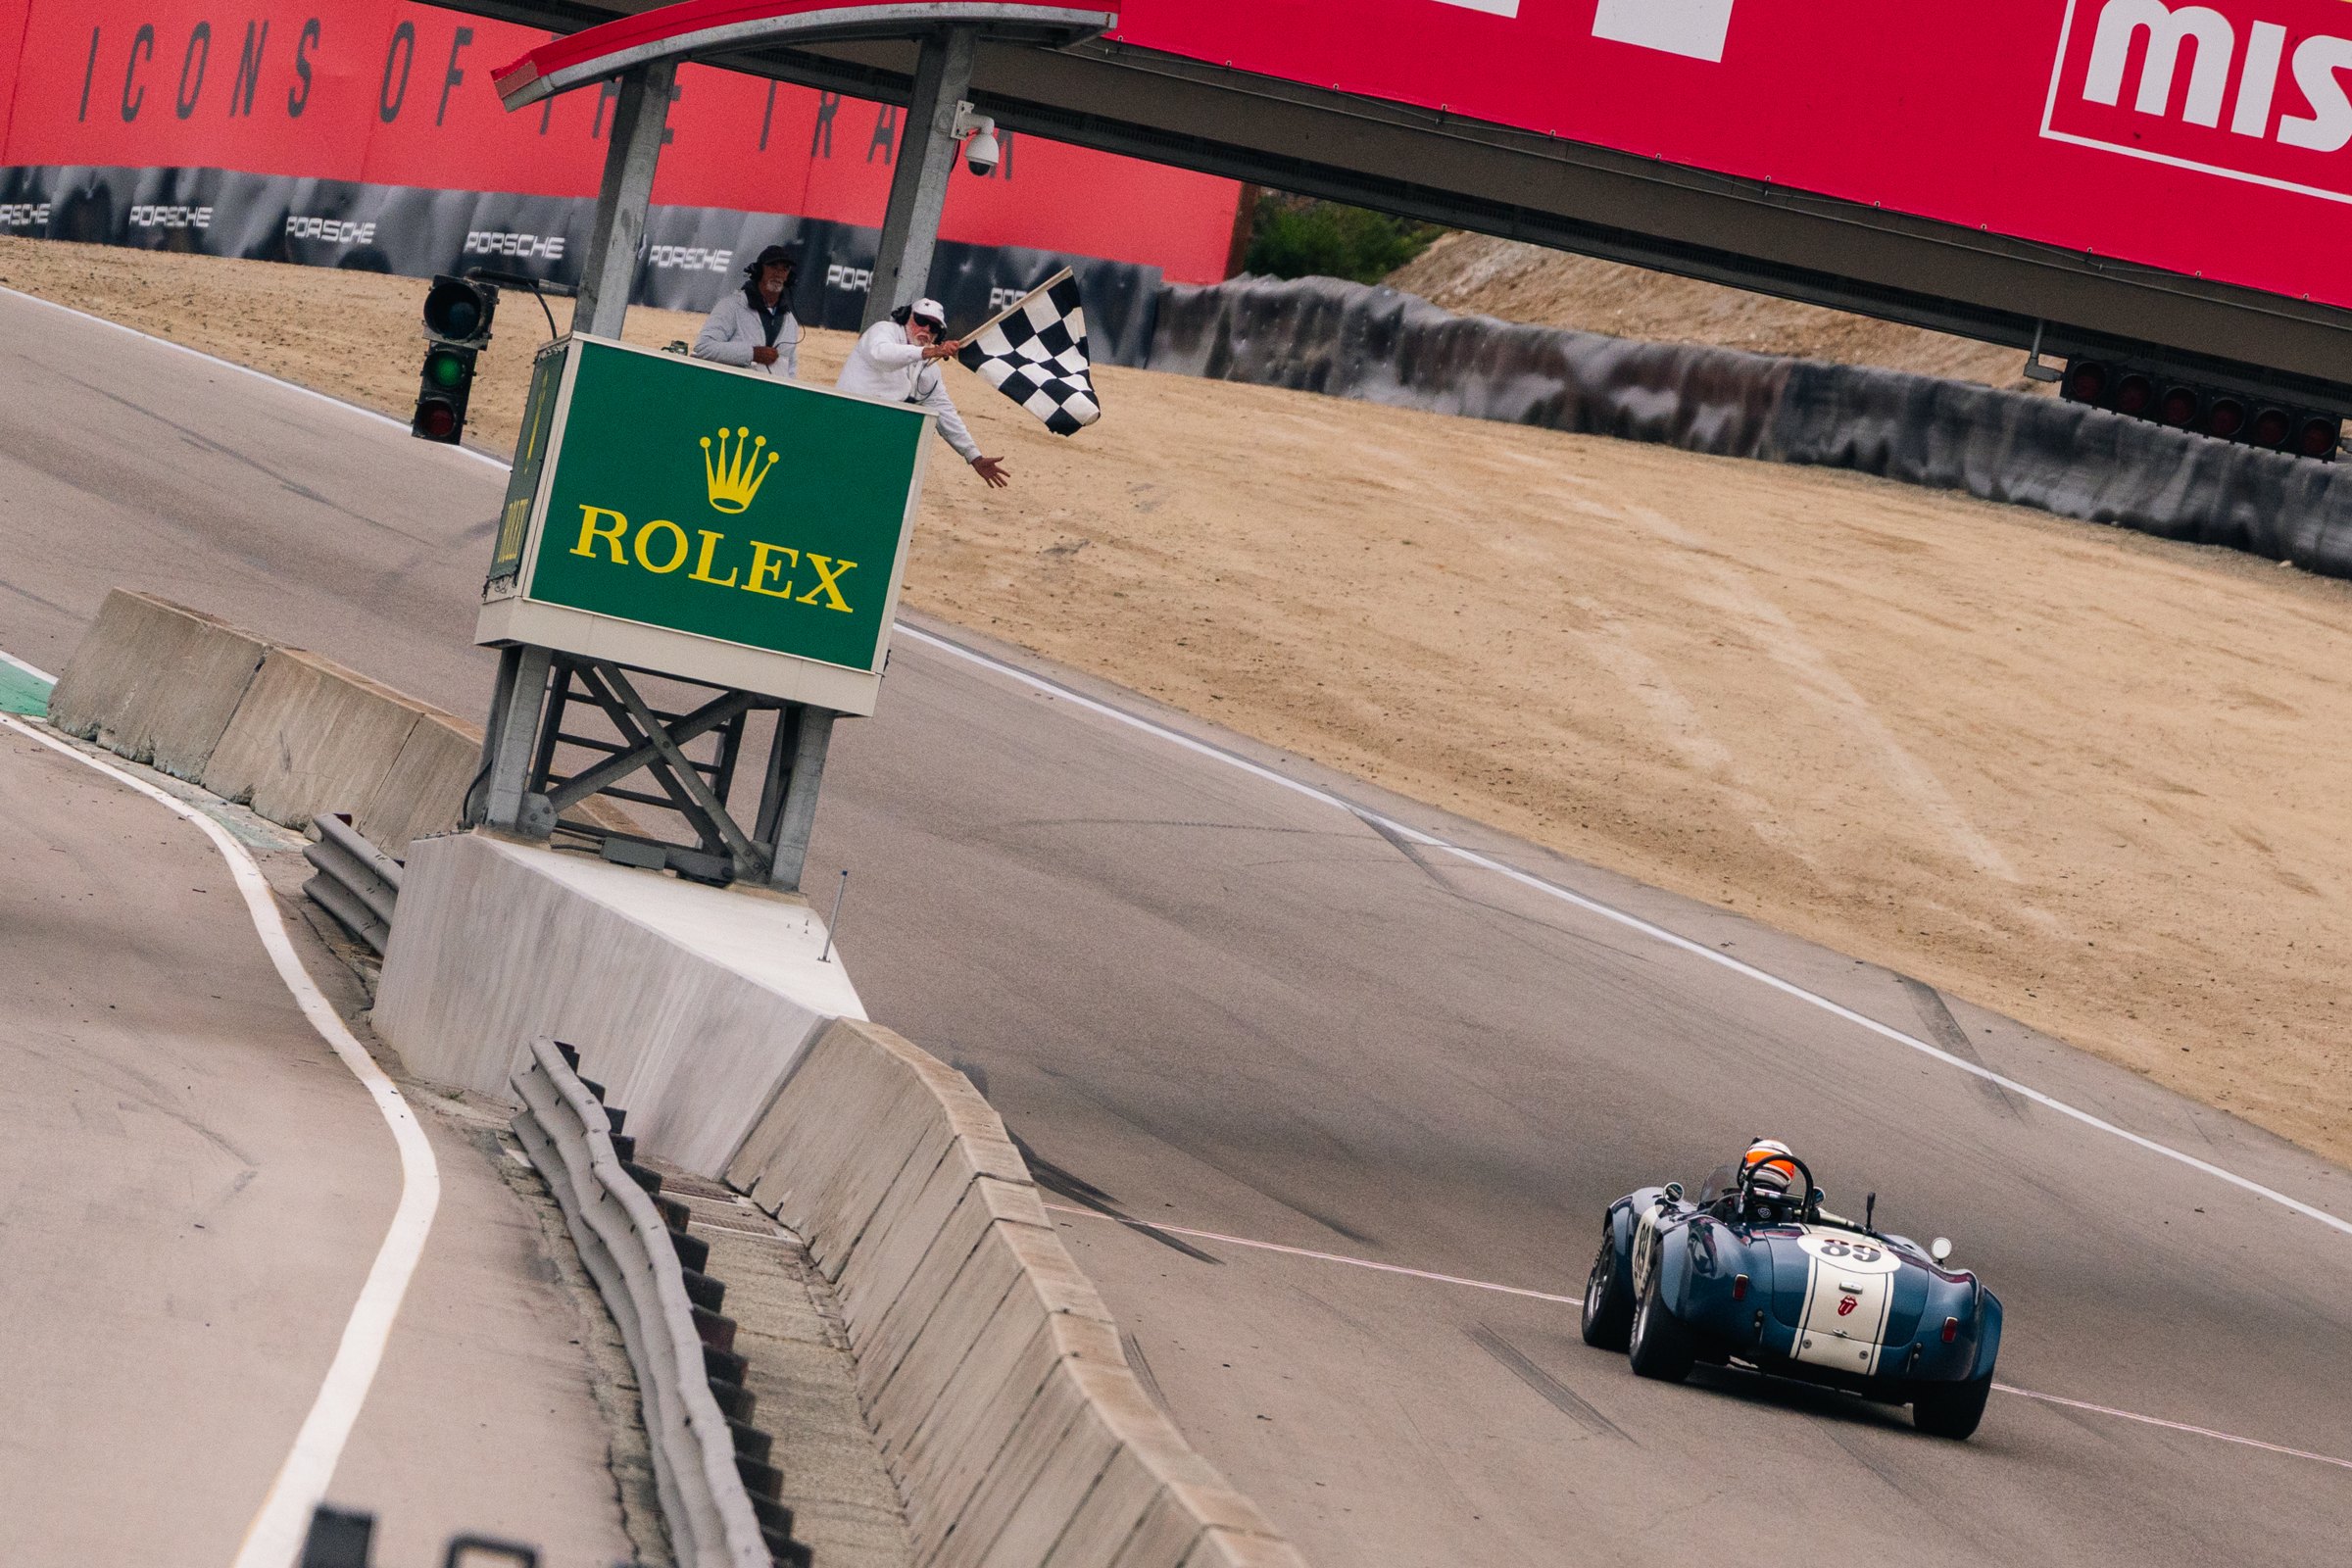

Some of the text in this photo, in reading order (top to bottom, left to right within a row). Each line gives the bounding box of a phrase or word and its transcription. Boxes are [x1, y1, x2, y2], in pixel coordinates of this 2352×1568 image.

[78, 18, 320, 123] ICONS
[379, 20, 473, 126] OF
[128, 205, 214, 228] PORSCHE
[285, 216, 376, 244] PORSCHE
[463, 231, 565, 259] PORSCHE
[649, 245, 733, 272] PORSCHE
[569, 504, 858, 613] ROLEX
[1820, 1239, 1882, 1263] 89
